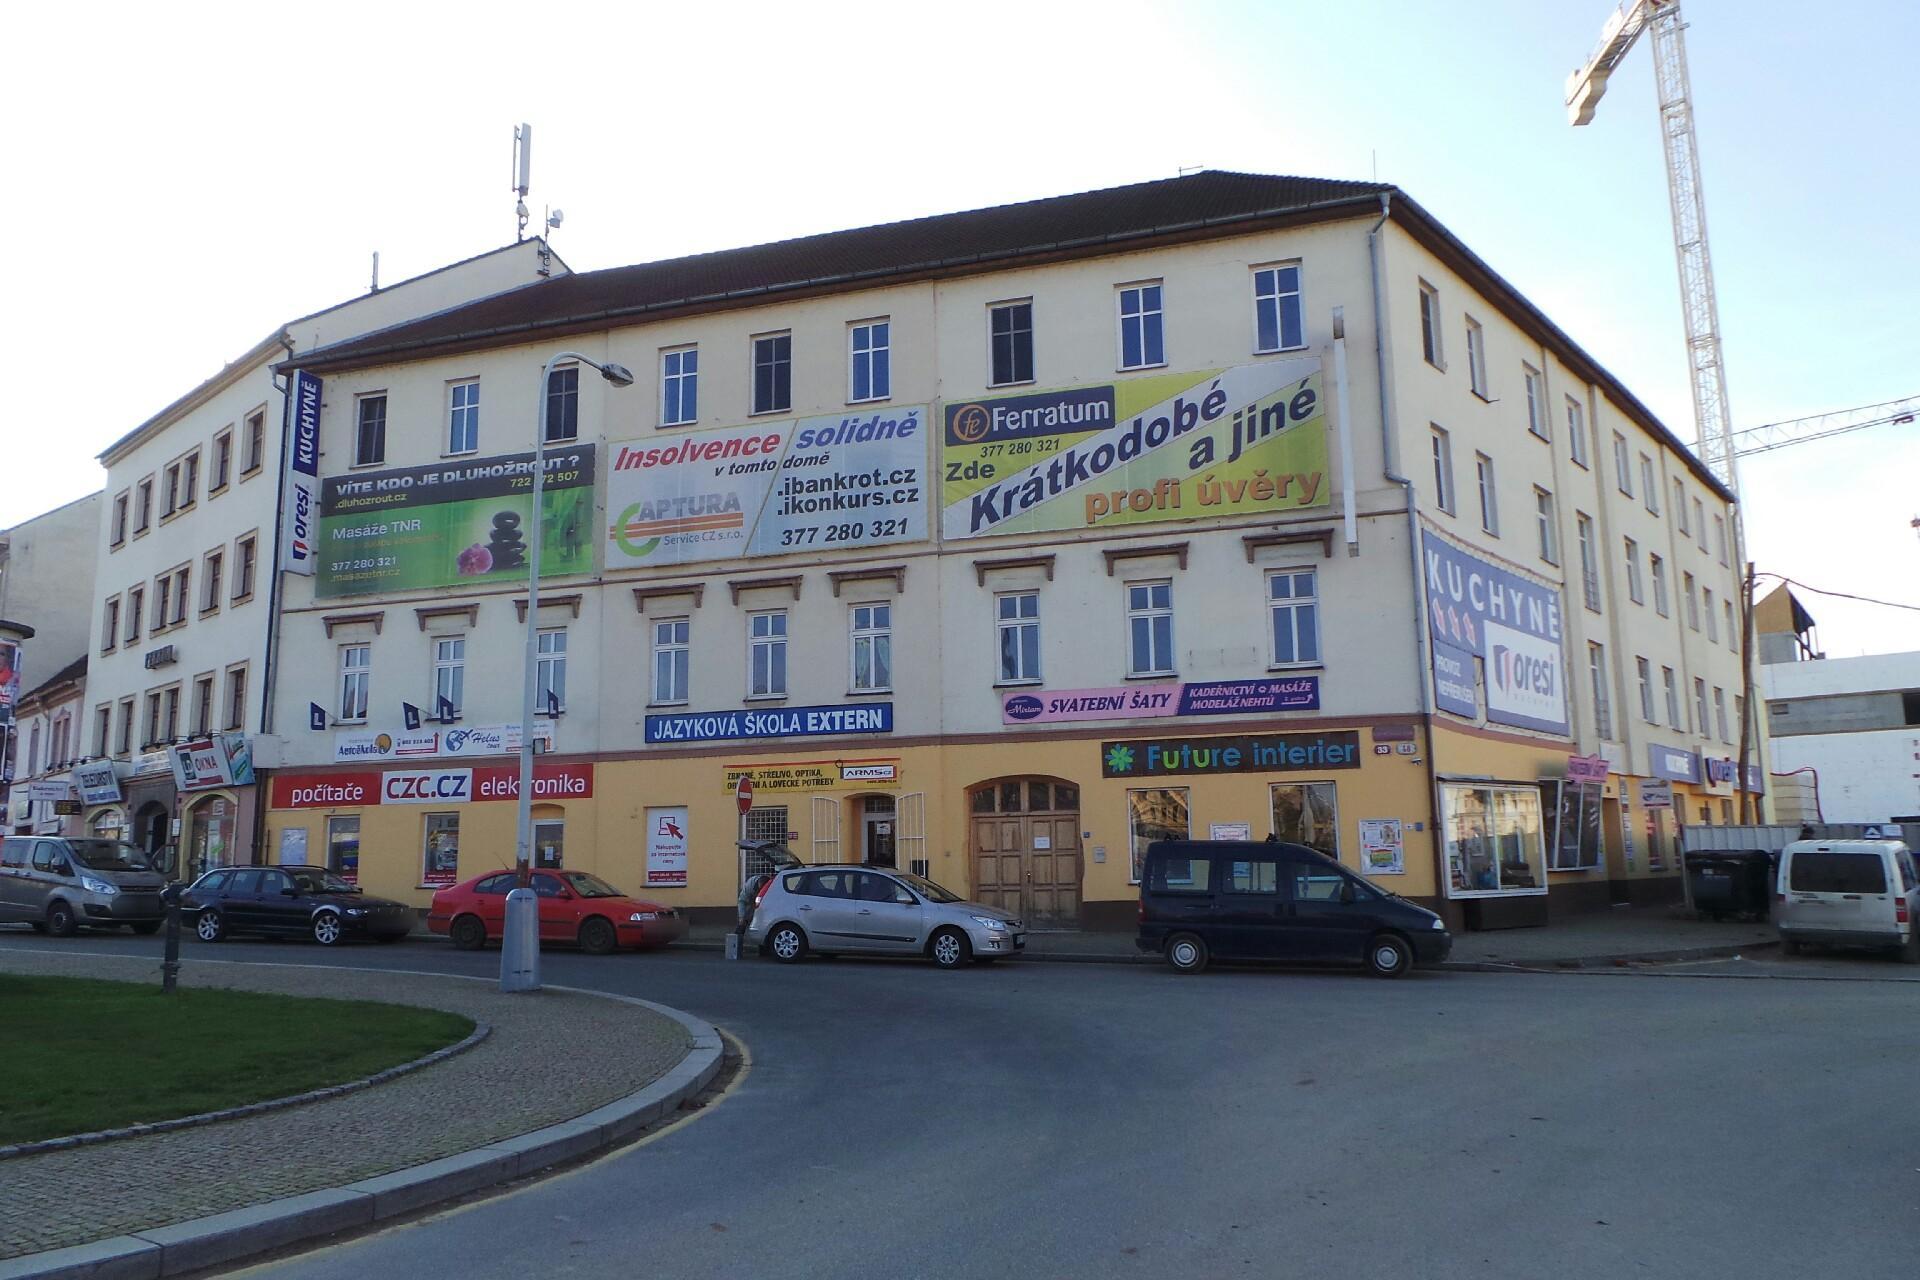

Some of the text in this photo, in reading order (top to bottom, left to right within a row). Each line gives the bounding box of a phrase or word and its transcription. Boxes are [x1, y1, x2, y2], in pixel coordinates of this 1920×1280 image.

[299, 380, 318, 466] KUCHYNĚ
[991, 398, 1110, 432] Ferratum
[1188, 377, 1317, 471] a jiné
[614, 410, 918, 471] Insolvence solidně
[980, 438, 1060, 459] 377 280 321
[714, 450, 830, 479] v tomto domě
[945, 460, 996, 482] Zde
[970, 378, 1228, 534] Krátkodobé
[336, 454, 580, 497] VÍTE KDO JE DLUHOŽROUT ?
[510, 477, 532, 489] 722
[557, 470, 580, 482] 507
[778, 466, 917, 496] .ibankrot.cz
[294, 482, 310, 540] oresi
[778, 486, 919, 516] .ikonkurs.cz
[1084, 468, 1323, 525] profi úvěry
[332, 518, 422, 540] Masáže TNR
[664, 530, 744, 546] Service CZ s.r.o.
[781, 517, 908, 547] 377 280 321
[331, 556, 397, 572] 377 280 321
[1427, 549, 1560, 639] KUCHYNĚ
[1189, 680, 1313, 698] KADEŘNICTVÍ MASÁŽE
[1513, 651, 1555, 697] oresi
[442, 706, 451, 721] L
[1049, 691, 1127, 714] SVATEBNÍ
[1130, 690, 1173, 711] ŠATY
[1190, 696, 1240, 711] MODELÁŽ
[1239, 694, 1275, 708] NEHTŮ
[313, 713, 322, 726] L
[407, 711, 418, 725] L
[654, 708, 883, 740] JAZYKOVÁ ŠKOLA EXTERN
[195, 755, 218, 772] OKNA
[1148, 739, 1355, 770] Future interier
[795, 767, 823, 778] OPTIKA,
[292, 782, 363, 807] počítače
[386, 775, 468, 799] CZC.CZ
